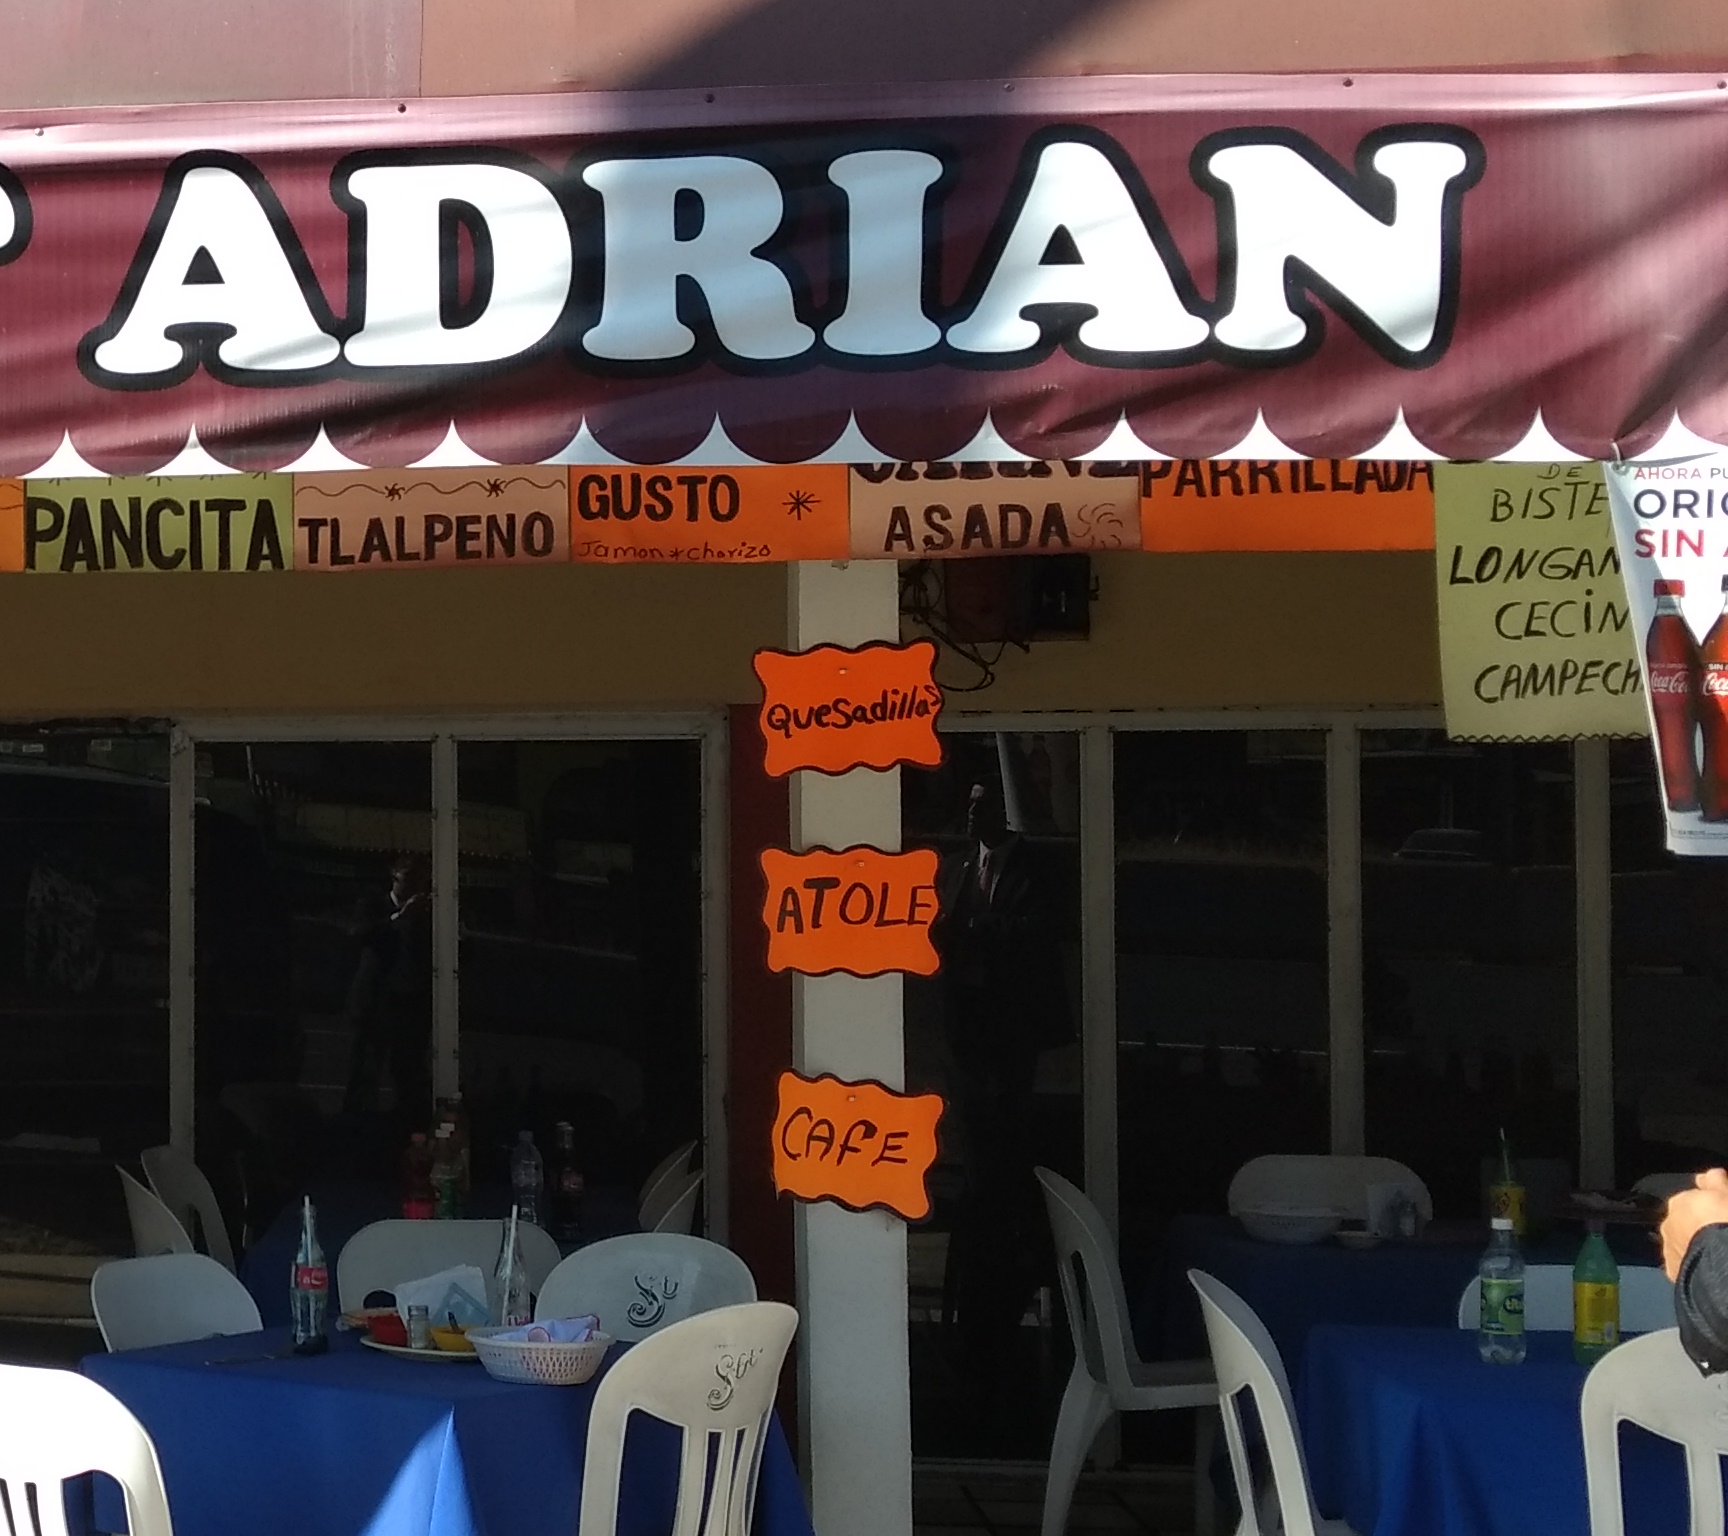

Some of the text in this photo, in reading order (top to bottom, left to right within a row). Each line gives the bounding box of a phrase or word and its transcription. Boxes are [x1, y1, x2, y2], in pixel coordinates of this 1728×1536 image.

[84, 132, 1477, 382] ADRIAN
[576, 472, 742, 524] GUSTO
[1633, 466, 1703, 481] AHORA
[882, 502, 1072, 552] ASADA
[1489, 480, 1611, 524] BISTE
[1633, 488, 1728, 520] ORI
[25, 495, 286, 572] PANCITA
[298, 511, 557, 567] TLALPENO
[1634, 529, 1705, 560] SIN
[1448, 544, 1622, 586] LONGAN
[1494, 588, 1631, 641] CECIN
[1473, 658, 1644, 705] CAMPECH
[776, 876, 936, 934] ATOLE
[780, 1106, 910, 1172] CAFE
